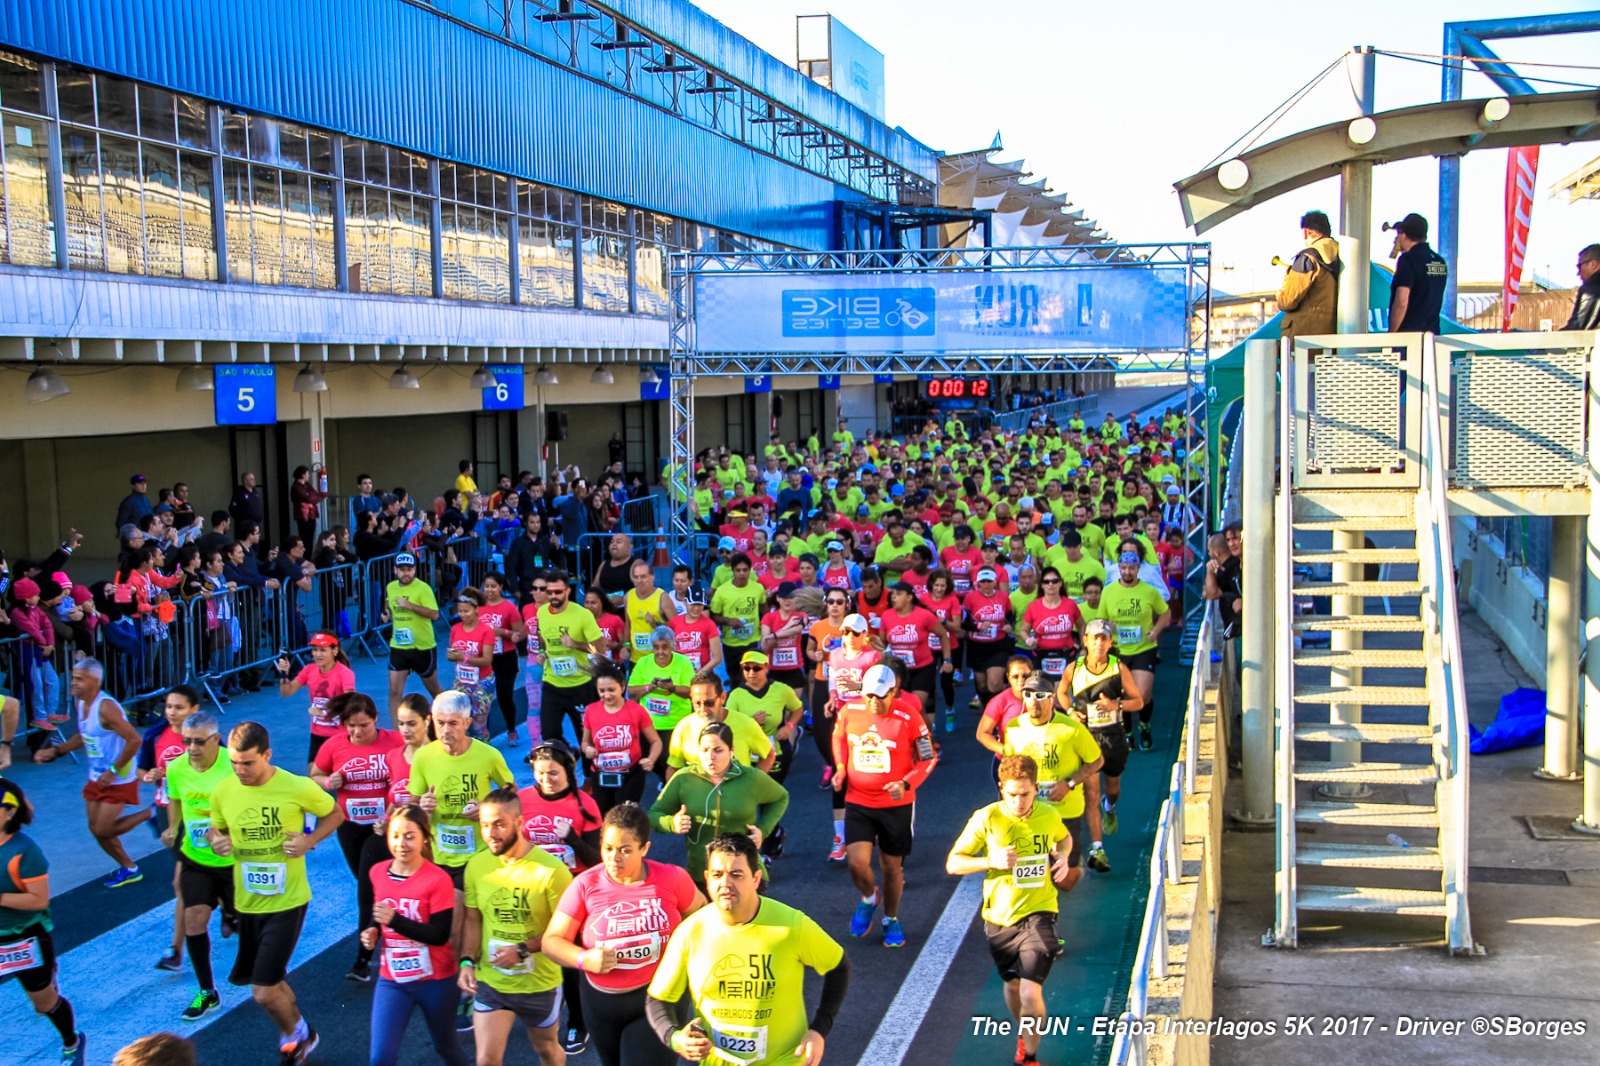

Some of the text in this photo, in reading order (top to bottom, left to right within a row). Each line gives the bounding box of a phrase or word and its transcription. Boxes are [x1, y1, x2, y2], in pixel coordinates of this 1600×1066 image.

[243, 367, 273, 376] PAULO
[496, 382, 509, 402] 6
[237, 387, 255, 412] 5
[1130, 599, 1141, 609] 5K
[491, 613, 503, 626] 5K
[1058, 614, 1070, 624] 5K
[905, 624, 917, 635] 5K
[690, 631, 702, 642] 5K
[466, 640, 479, 653] 5K
[616, 725, 631, 739] 5K
[1044, 743, 1059, 760] 5K
[369, 754, 389, 770] 5K
[462, 774, 479, 792] 5K
[262, 806, 282, 826] 5K
[352, 806, 378, 816] 0162
[442, 833, 467, 845] 0288
[1033, 834, 1049, 854] 5K
[247, 873, 276, 884] 0391
[1016, 866, 1045, 878] 0245
[513, 887, 531, 909] 5K
[399, 898, 421, 920] 5K
[639, 897, 667, 917] 5K
[616, 946, 651, 959] 0150
[749, 954, 775, 980] 5K
[754, 1009, 772, 1020] 2017
[719, 1036, 757, 1053] 0223
